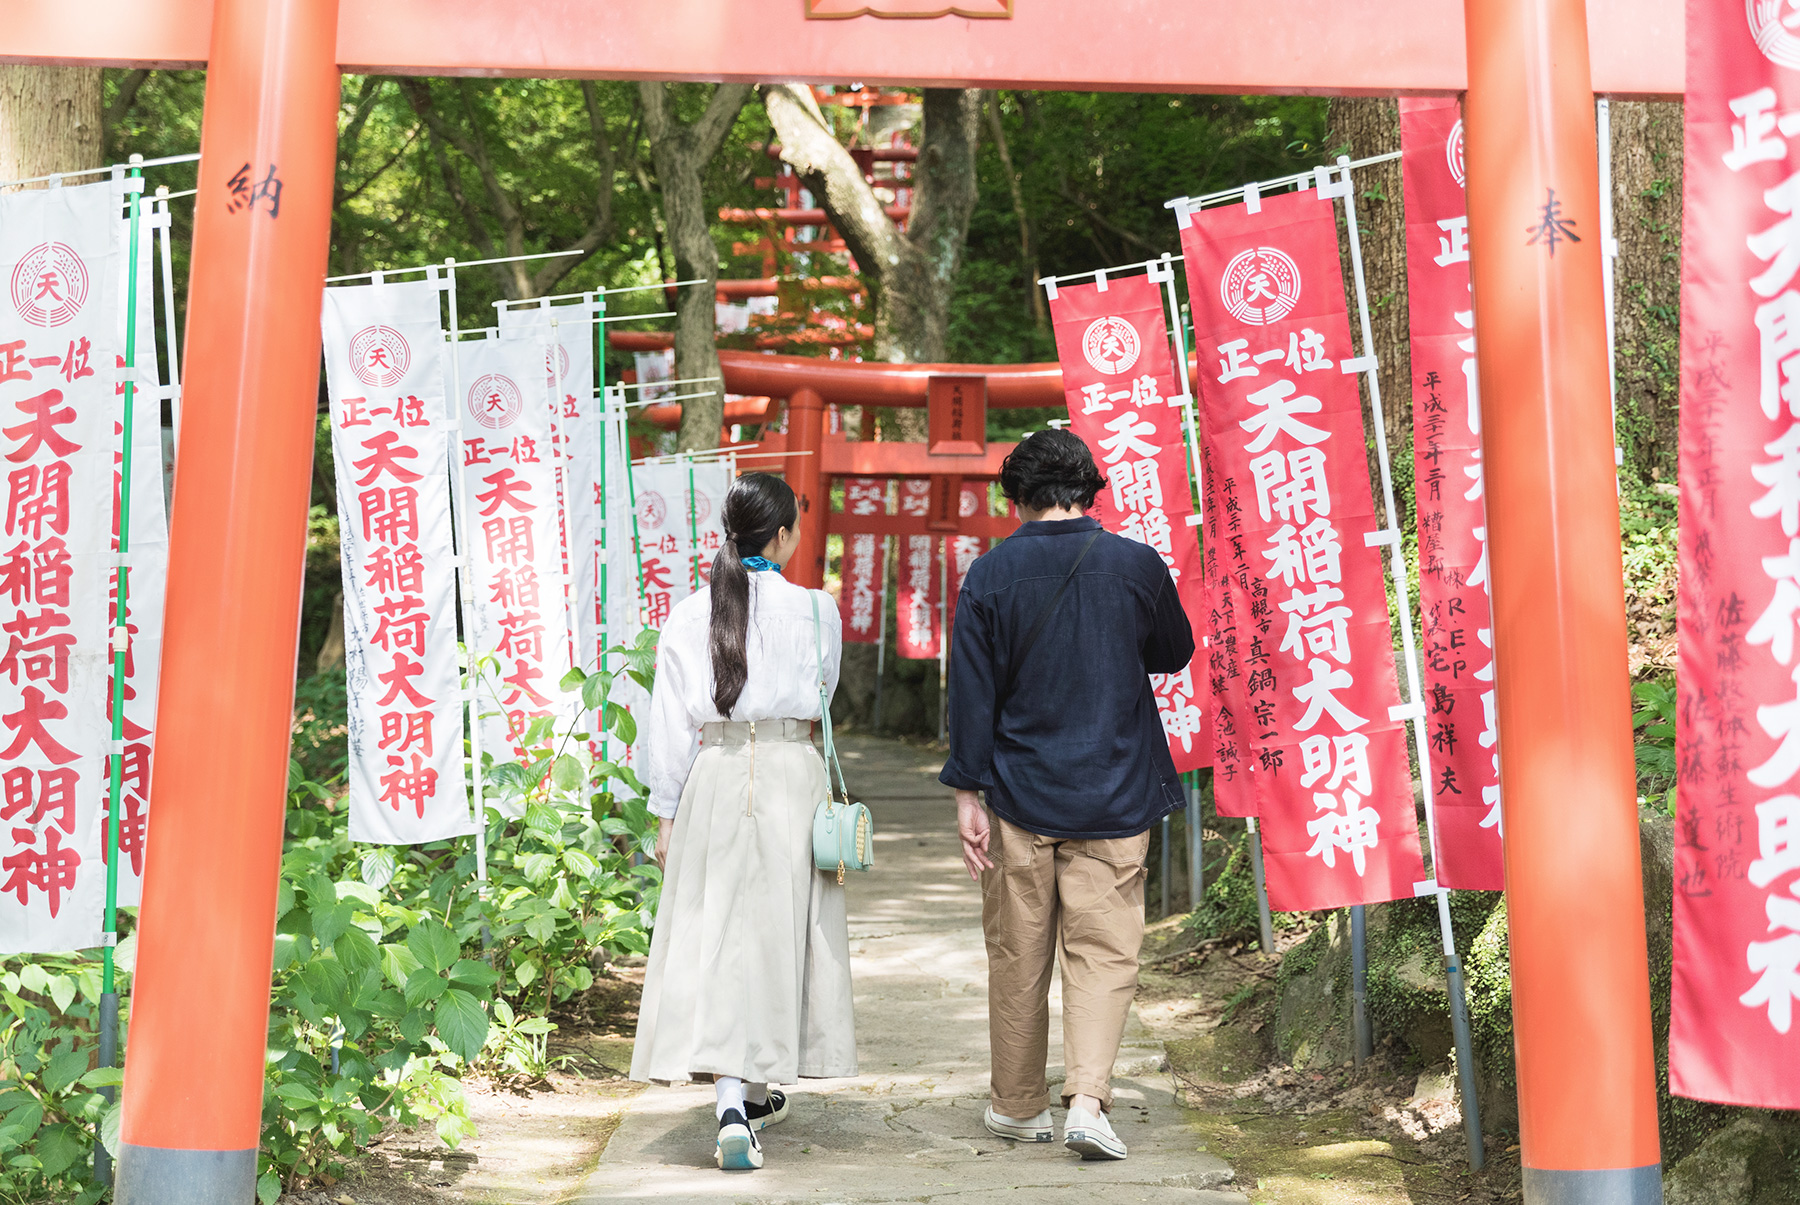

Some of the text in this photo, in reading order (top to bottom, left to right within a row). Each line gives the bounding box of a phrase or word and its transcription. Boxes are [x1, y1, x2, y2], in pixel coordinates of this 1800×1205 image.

[226, 162, 283, 219] 納
[1526, 187, 1581, 259] 奉
[35, 271, 64, 302] 天
[1247, 273, 1277, 303] 天
[0, 336, 95, 384] 正一位
[368, 348, 391, 369] 天
[1101, 337, 1124, 358] 天
[1216, 328, 1334, 384] 正一位
[339, 395, 431, 430] 正一位
[486, 394, 505, 412] 天
[1080, 374, 1164, 415] 正一位
[463, 435, 541, 467] 正一位
[1422, 371, 1447, 501] 平成三十一年三月
[1222, 477, 1251, 591] 平成三十一年二月
[352, 430, 440, 820] 天開稲荷大明神
[1238, 379, 1382, 878] 天開稲荷大明神
[0, 388, 84, 920] 天開稲荷大明神
